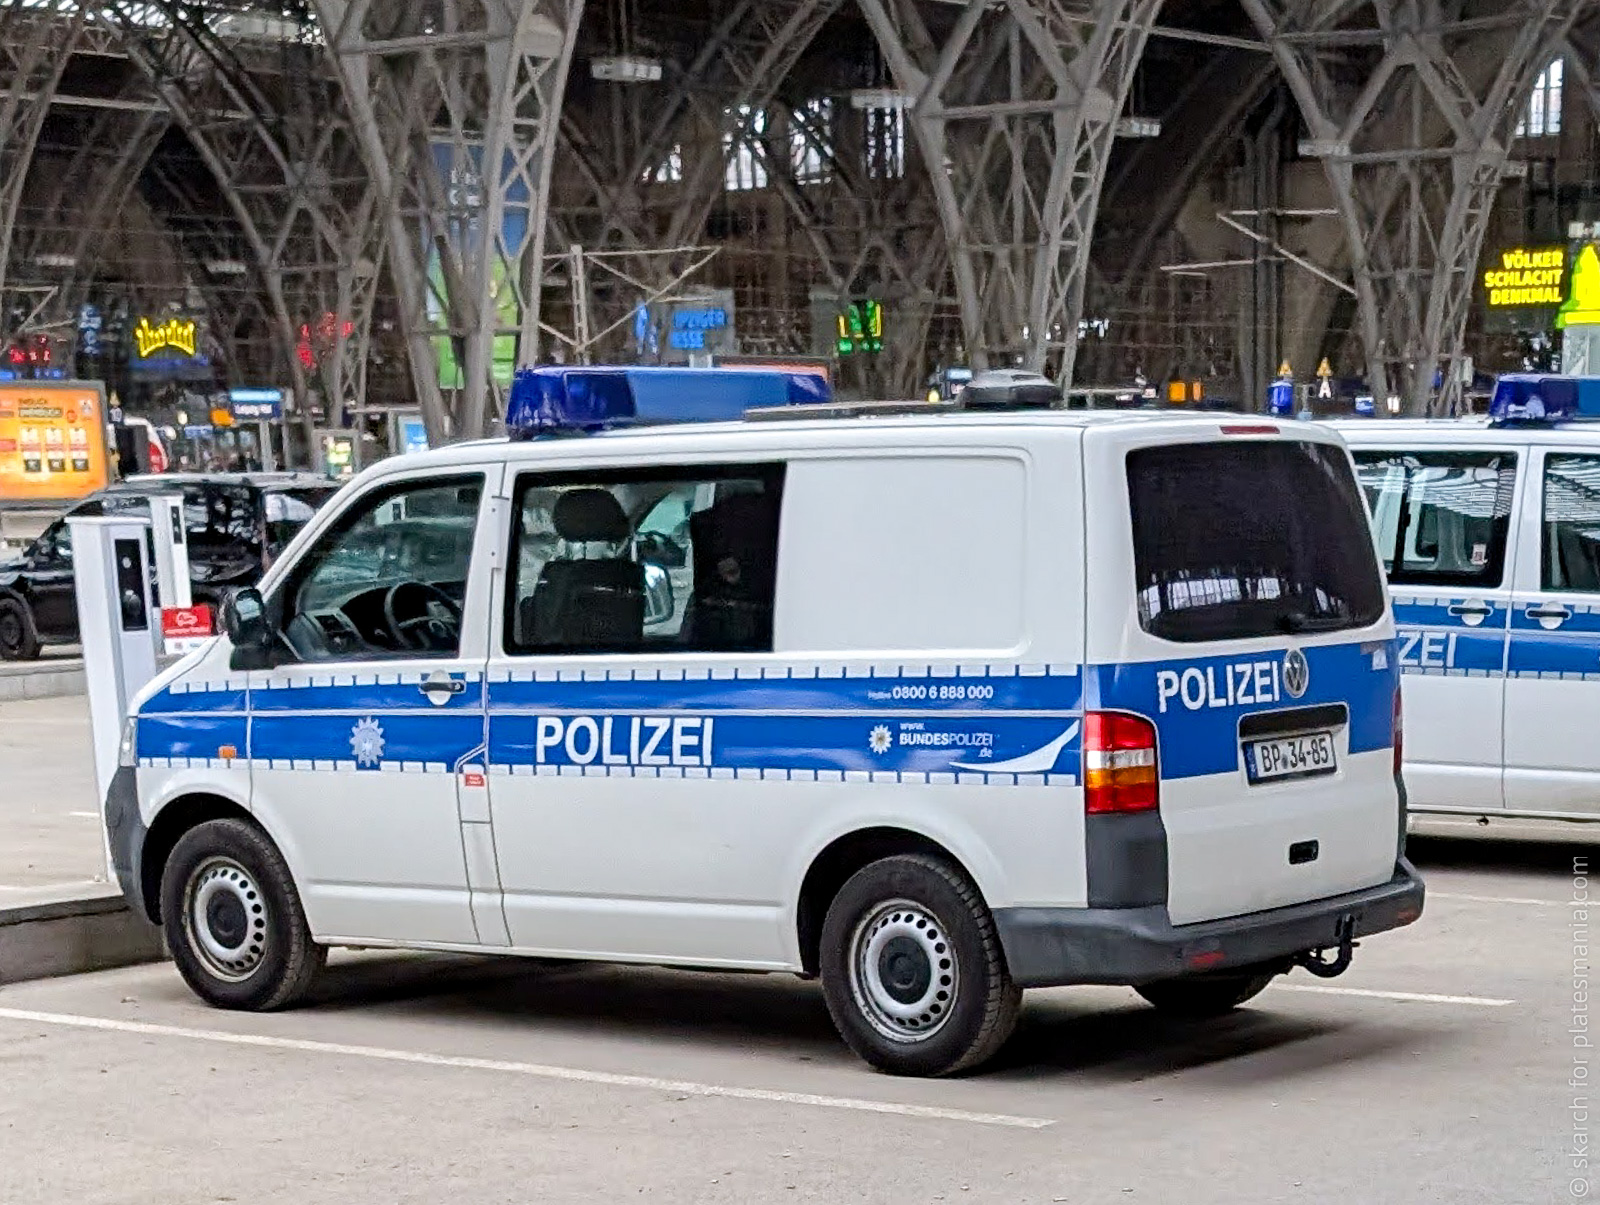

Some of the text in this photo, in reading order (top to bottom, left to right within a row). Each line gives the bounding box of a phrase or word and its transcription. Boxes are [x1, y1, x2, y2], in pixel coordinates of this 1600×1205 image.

[1503, 250, 1563, 269] VÖLKER
[1485, 269, 1563, 287] SCHLACHT
[1490, 287, 1562, 305] DENKMAL
[892, 685, 927, 699] 0800
[928, 685, 938, 699] 6
[940, 685, 965, 699] 888
[967, 685, 994, 699] 000
[1157, 660, 1280, 713] POLIZEI
[536, 716, 714, 766] POLIZEI
[899, 732, 993, 746] BUNDESPOLIZEI
[1261, 738, 1329, 772] BP 34-85
